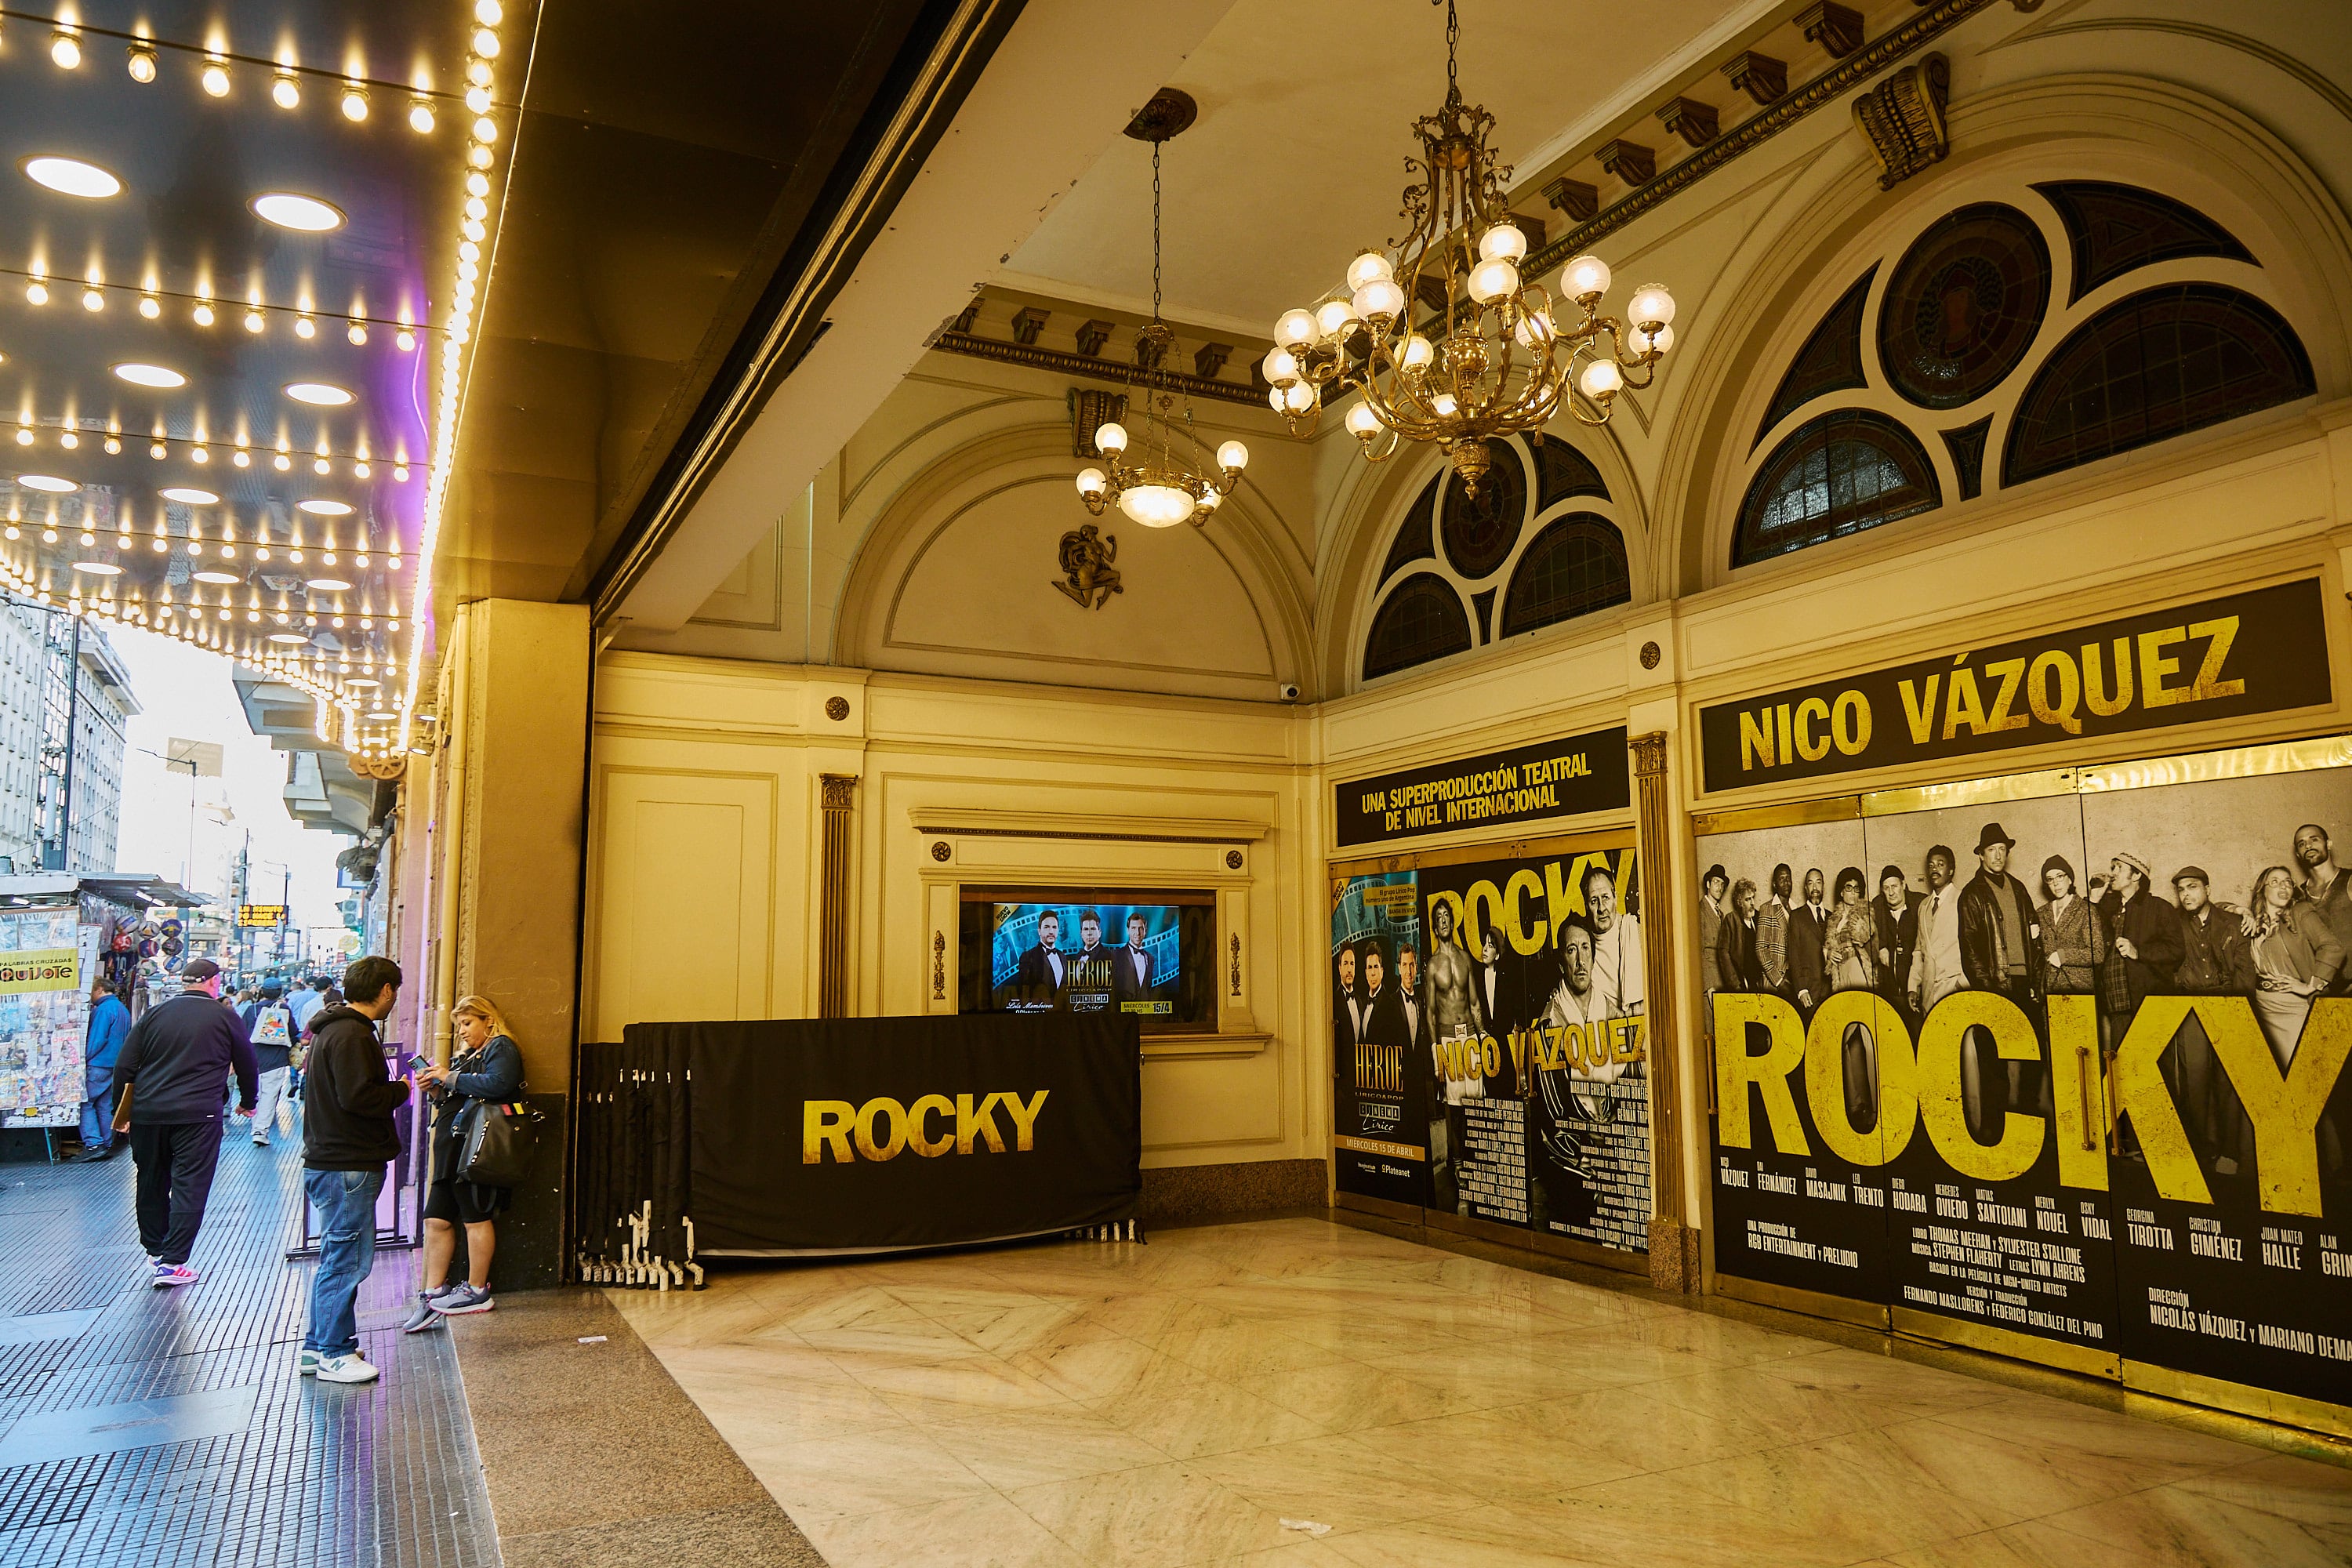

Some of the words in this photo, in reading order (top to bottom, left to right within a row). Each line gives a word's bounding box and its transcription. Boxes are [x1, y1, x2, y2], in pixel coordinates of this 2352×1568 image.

[1740, 690, 1872, 771] NICO
[1898, 615, 2245, 734] VÁZQUEZ
[1363, 792, 1386, 814] UNA
[1389, 764, 1518, 808] SUPERPRODUCCIÓN
[1523, 753, 1592, 786] TEATRAL
[1385, 811, 1402, 831] DE
[1406, 804, 1442, 829] NIVEL
[1447, 785, 1559, 822] INTERNACIONAL
[1427, 848, 1635, 963] ROCKY
[1066, 960, 1112, 986] HEROE
[1153, 1004, 1170, 1013] 15/4
[1436, 1036, 1501, 1082] NICO
[1507, 1016, 1646, 1076] VÁZQUEZ
[1355, 1044, 1403, 1092] HEROE
[1570, 1081, 1589, 1094] MARIANO
[1610, 1084, 1631, 1098] GUSTAVO
[1360, 1104, 1399, 1119] CINEMA
[1711, 990, 2352, 1218] ROCKY
[803, 1090, 1050, 1165] ROCKY
[1347, 1138, 1377, 1151] MIÉRCOLES
[1380, 1143, 1386, 1152] 15
[1388, 1145, 1395, 1153] DE
[1396, 1146, 1414, 1157] ABRIL
[1386, 1165, 1410, 1178] Plateanet
[1721, 1166, 1749, 1188] VÁZQUEZ
[1758, 1172, 1797, 1195] FERNÁNDEZ
[1806, 1179, 1847, 1202] MASAJNIK
[1892, 1178, 1905, 1190] DIEGO
[1935, 1184, 1959, 1198] MERCEDES
[1853, 1185, 1884, 1207] TRENTO
[1893, 1191, 1927, 1214] HODARA
[1936, 1196, 1969, 1220] OVIEDO
[1977, 1203, 2027, 1229] SANTOIANI
[2081, 1201, 2095, 1215] OSKY
[2126, 1207, 2154, 1224] GEORGINA
[1748, 1220, 1756, 1232] UNA
[1759, 1223, 1788, 1237] PRODUCCIÓN
[1790, 1227, 1796, 1239] DE
[2036, 1210, 2069, 1234] NOUEL
[2081, 1217, 2112, 1240] VIDAL
[2189, 1217, 2221, 1234] CHRISTIAN
[1913, 1228, 1927, 1240] LIBRO
[1929, 1225, 1958, 1245] THOMAS
[1961, 1231, 1991, 1250] MEEHAN
[1998, 1236, 2040, 1258] SYLVESTER
[2043, 1243, 2082, 1265] STALLONE
[2128, 1223, 2173, 1250] TIROTTA
[2190, 1231, 2243, 1261] GIMÉNEZ
[2261, 1226, 2278, 1242] JUAN
[2281, 1229, 2303, 1245] MATEO
[2321, 1234, 2337, 1250] ALAN
[1748, 1232, 1762, 1250] RGB
[1763, 1236, 1816, 1261] ENTERTAINMENT
[1824, 1247, 1858, 1269] PRELUDIO
[2262, 1243, 2301, 1270] HALLE
[1911, 1242, 1932, 1256] MÚSICA
[1933, 1243, 1965, 1262] STEPHEN
[1966, 1247, 2002, 1269] FLAHERTY
[2009, 1259, 2029, 1273] LETRAS
[2031, 1258, 2051, 1276] LYNN
[2053, 1262, 2085, 1283] AHRENS
[1929, 1262, 1949, 1276] BASADO
[1951, 1265, 1958, 1277] EN
[1960, 1267, 1966, 1279] LA
[1968, 1267, 1992, 1283] PELÍCULA
[1994, 1272, 2001, 1285] DE
[2003, 1275, 2041, 1292] MGM-UNITED
[2043, 1281, 2067, 1297] ARTISTS
[1966, 1285, 1987, 1299] VERSIÓN
[1990, 1289, 1993, 1300] Y
[1994, 1290, 2027, 1306] TRADUCCIÓN
[2148, 1287, 2189, 1308] DIRECCIÓN
[1904, 1285, 1937, 1305] FERNANDO
[1940, 1292, 1984, 1315] MASLLORENS
[1992, 1303, 2026, 1323] FEDERICO
[2028, 1311, 2065, 1331] GONZÁLEZ
[2067, 1318, 2082, 1334] DEL
[2083, 1320, 2103, 1339] PINO
[2150, 1304, 2196, 1332] NICOLÁS
[2199, 1310, 2246, 1342] VÁZQUEZ
[2258, 1324, 2314, 1355] MARIANO
